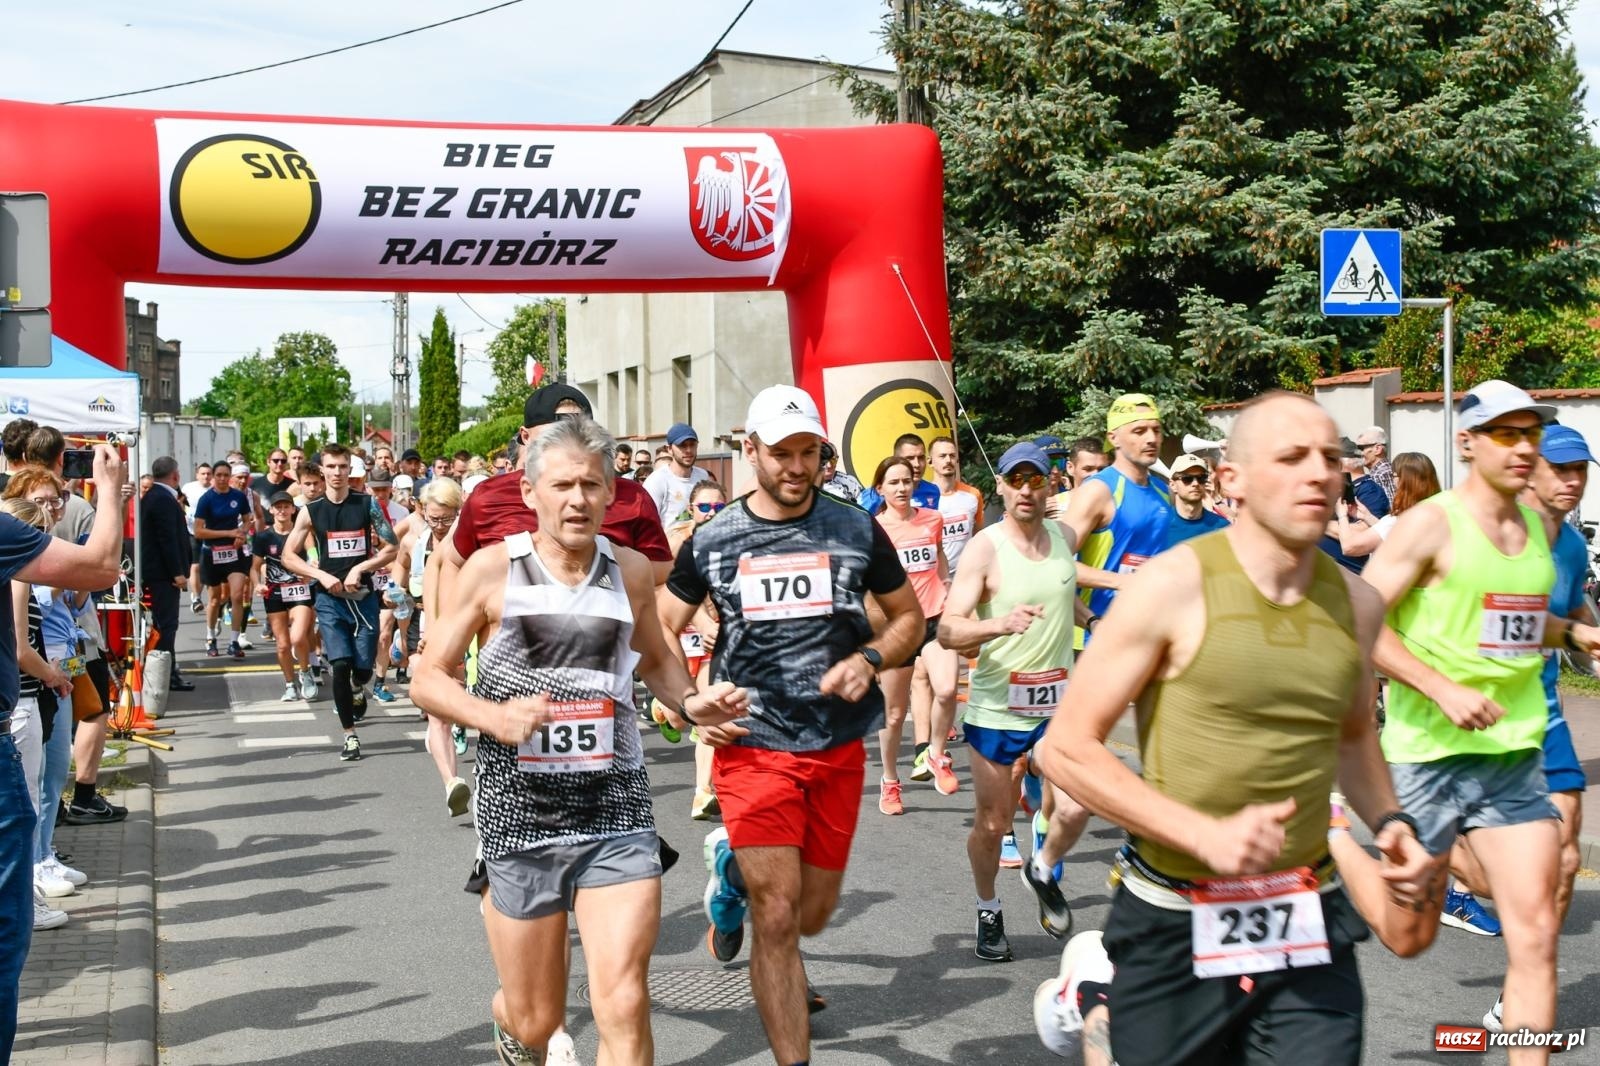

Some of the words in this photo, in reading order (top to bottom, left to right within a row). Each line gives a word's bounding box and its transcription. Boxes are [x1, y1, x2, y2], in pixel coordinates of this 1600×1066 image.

[241, 153, 317, 180] SIR
[443, 143, 555, 168] BIEG
[358, 185, 459, 218] BEZ
[466, 188, 641, 219] GRANIC
[378, 230, 618, 266] RACIBÓRZ
[88, 404, 116, 412] MITKO
[904, 401, 953, 429] SIR
[943, 523, 965, 536] 144
[336, 539, 358, 550] 157
[904, 548, 931, 564] 186
[288, 586, 305, 596] 219
[761, 574, 811, 602] 170
[1500, 614, 1537, 641] 132
[1026, 685, 1057, 705] 121
[537, 724, 597, 753] 135
[1220, 902, 1294, 945] 237
